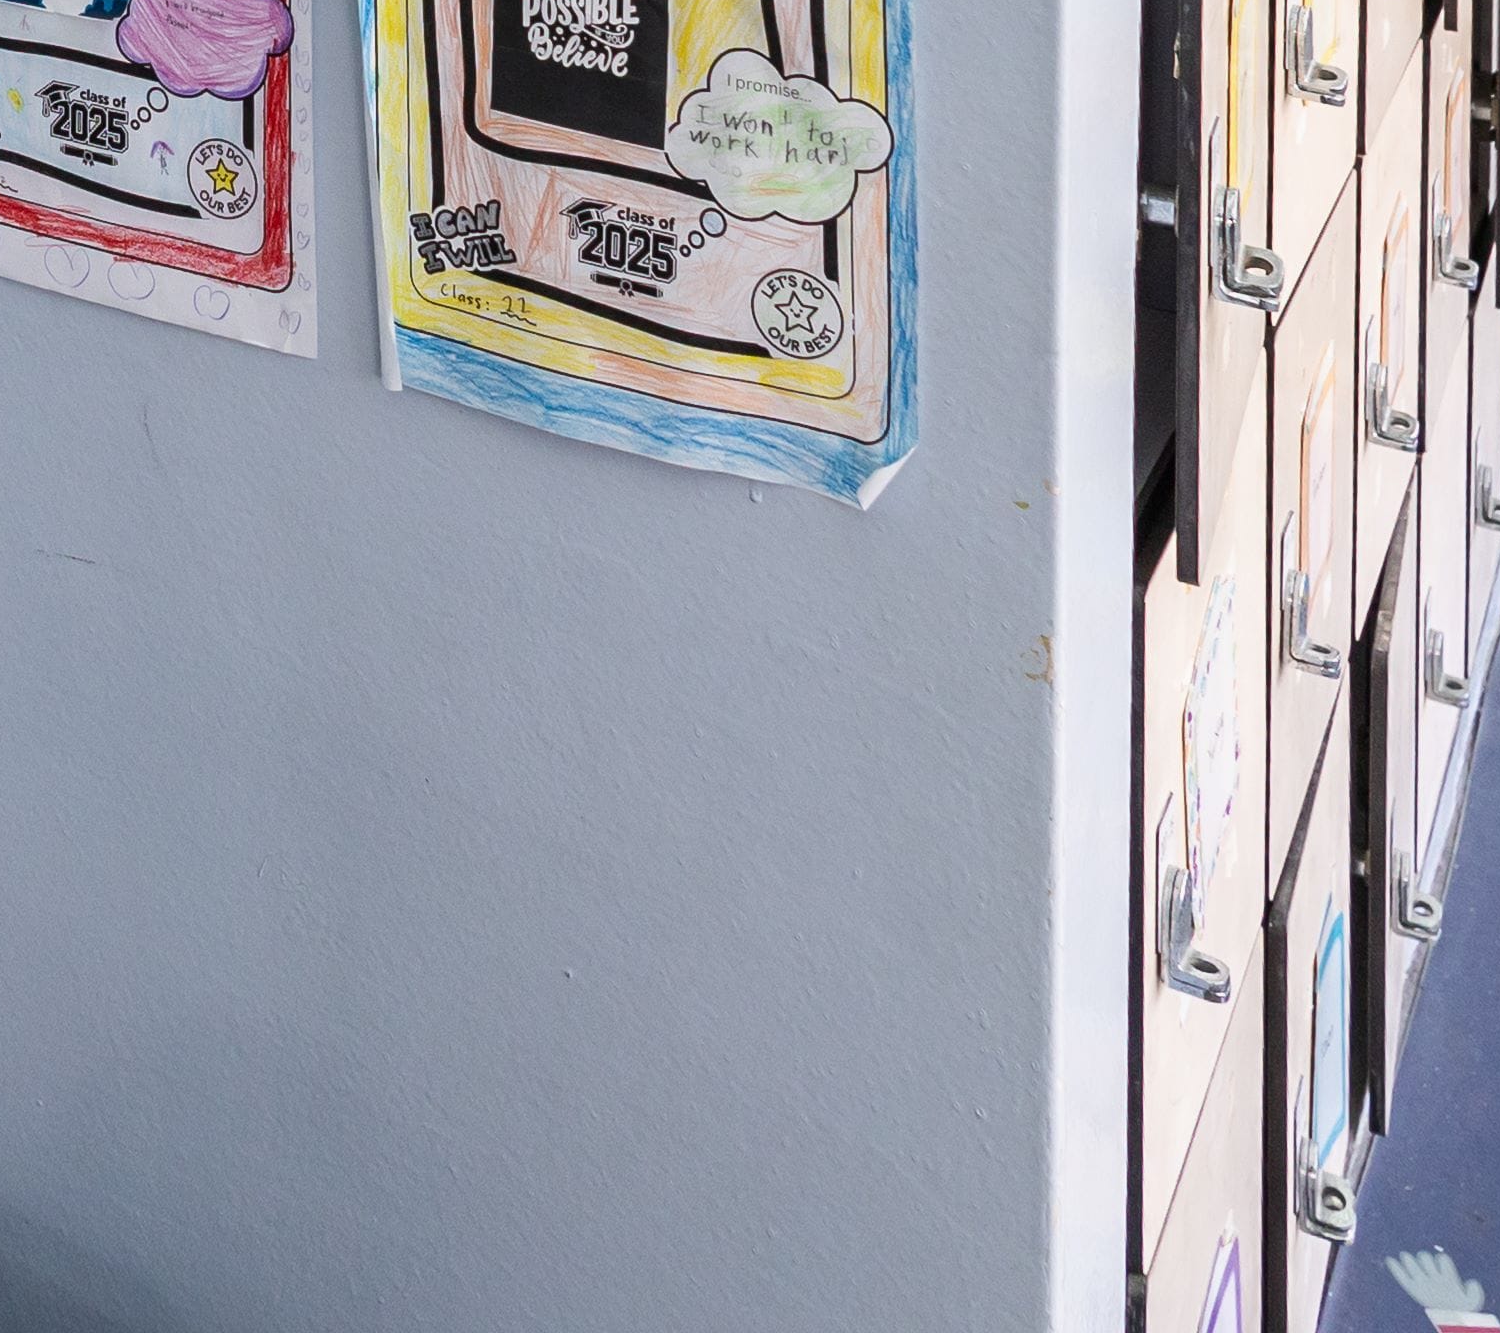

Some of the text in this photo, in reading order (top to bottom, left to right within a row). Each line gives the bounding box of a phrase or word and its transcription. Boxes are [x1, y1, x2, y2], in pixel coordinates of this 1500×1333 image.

[528, 27, 629, 78] Believe
[50, 101, 129, 151] 2025
[580, 224, 678, 282] 2025
